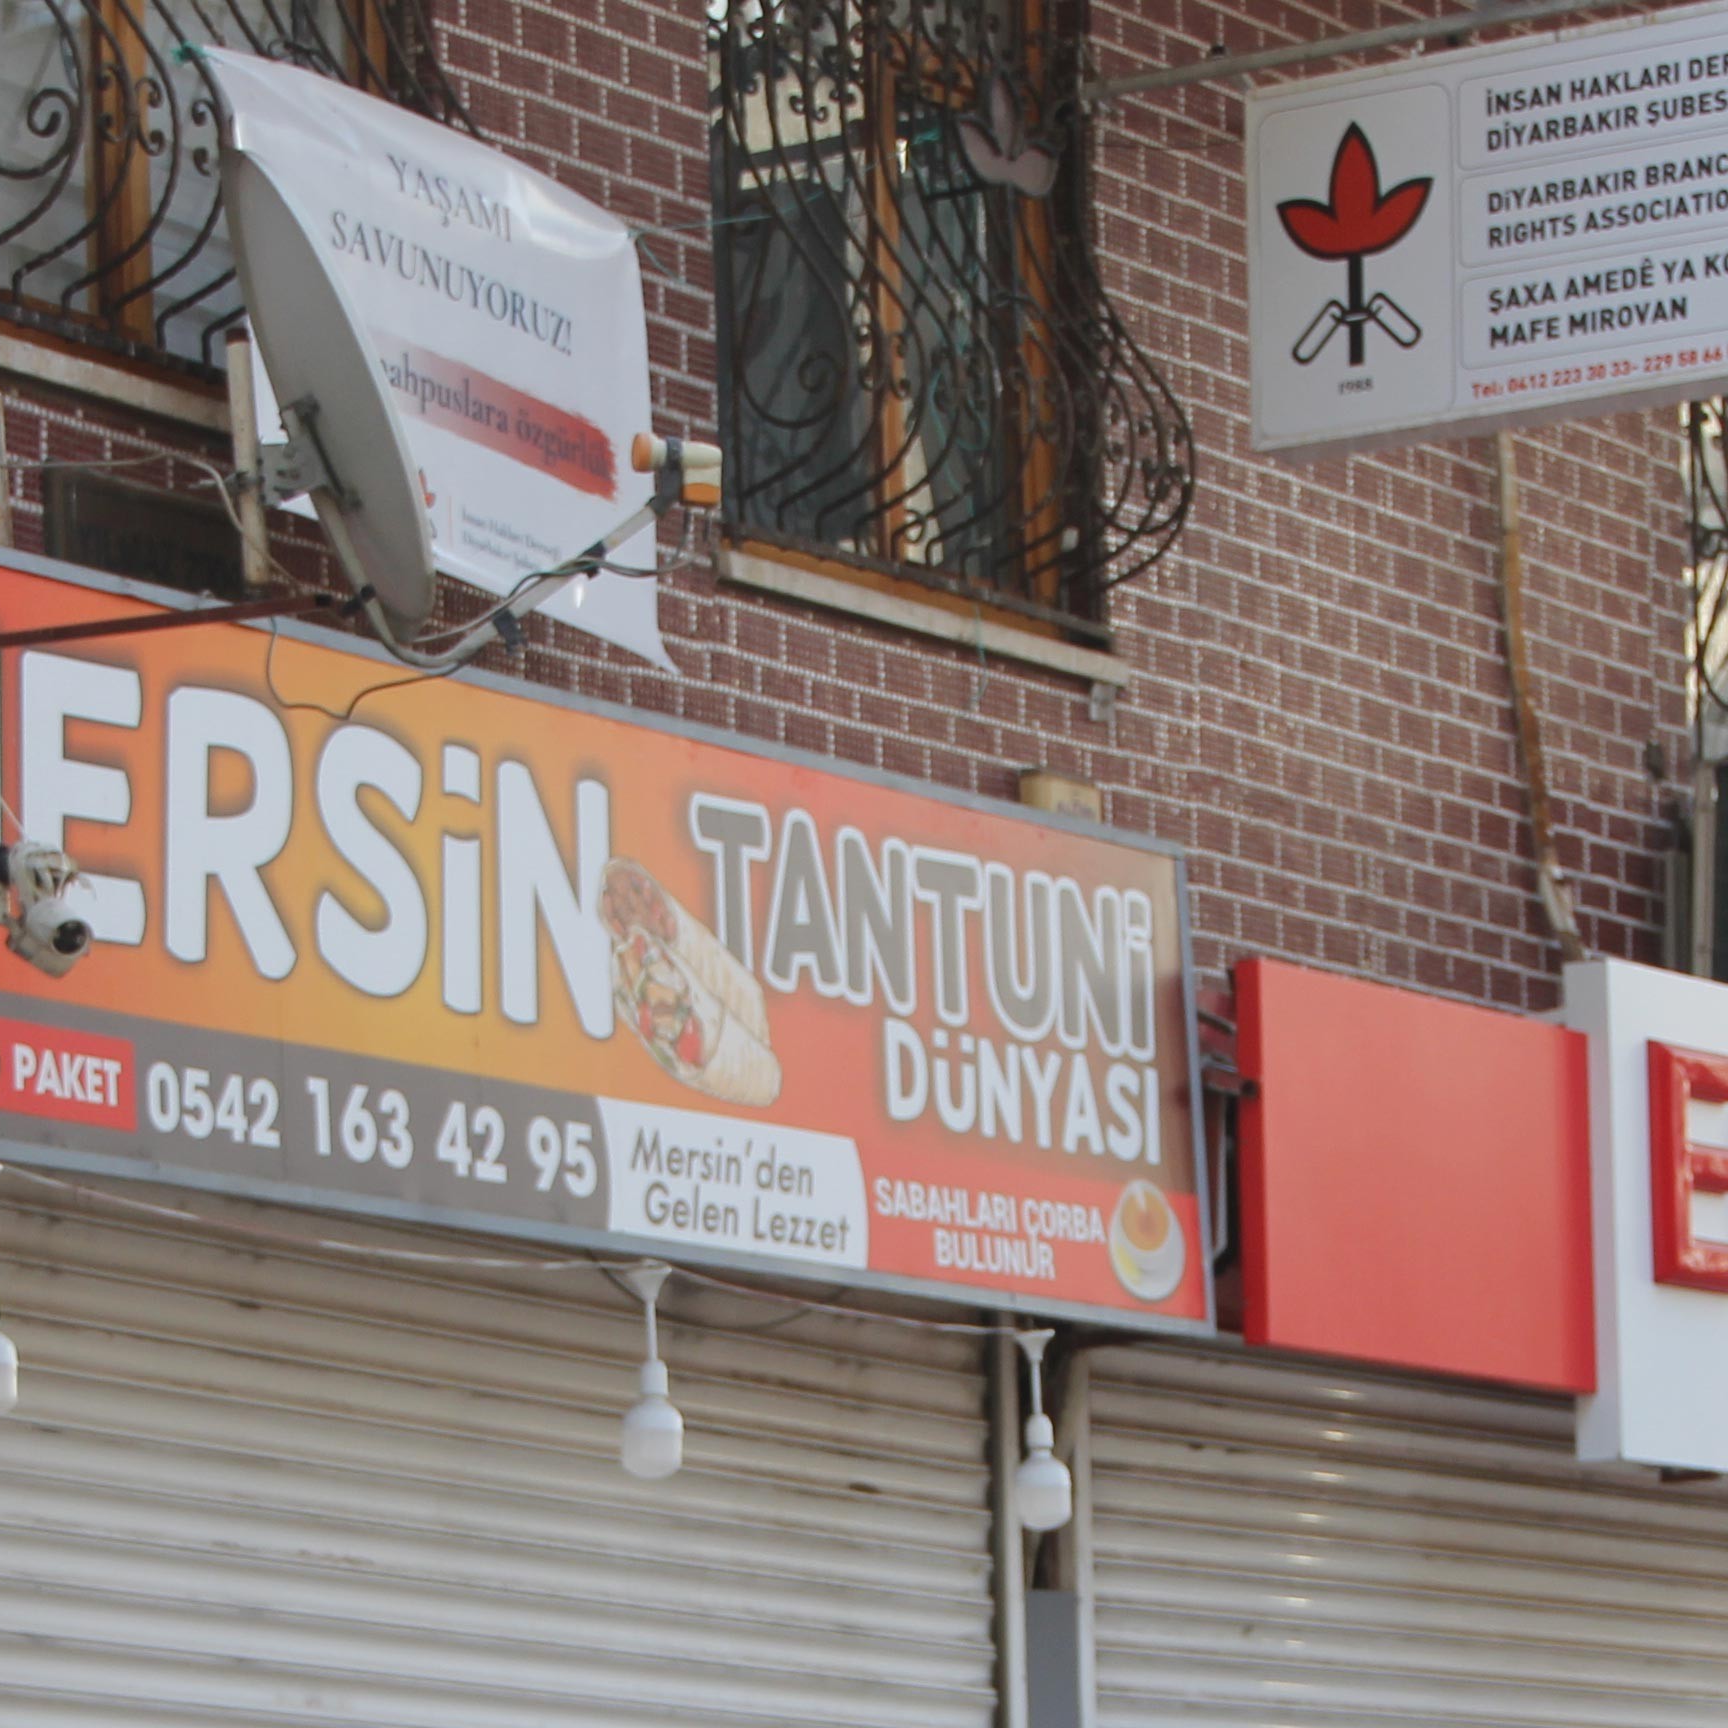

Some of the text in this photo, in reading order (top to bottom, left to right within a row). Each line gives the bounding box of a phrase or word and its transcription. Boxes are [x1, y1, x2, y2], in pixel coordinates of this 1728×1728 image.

[1486, 83, 1562, 117] İNSAN
[1571, 61, 1680, 103] HAKLARI
[1486, 105, 1639, 153] DİYARBAKIR
[386, 152, 513, 243] YAŞAMI
[1488, 214, 1577, 249] RIGHTS
[331, 209, 572, 358] SAVUNUYORUZ!
[1488, 279, 1556, 316] ŞAXA
[1564, 258, 1654, 300] AMEDÊ
[1660, 256, 1697, 284] YA
[1488, 297, 1689, 350] MAFE MIROVAN
[1507, 373, 1549, 394] 0412
[1552, 367, 1583, 387] 223
[1586, 363, 1607, 382] 30
[1643, 353, 1673, 374] 229
[1677, 350, 1698, 367] 58
[1702, 347, 1723, 364] 66
[12, 1043, 122, 1108] PAKET
[145, 1061, 281, 1149] 0542
[305, 1076, 414, 1170] 163
[435, 1101, 509, 1184] 42
[528, 1115, 598, 1198] 95
[883, 1017, 1162, 1166] DÜNYASI
[629, 1126, 815, 1197] Mersin'den
[643, 1180, 851, 1254] Gelen Lezzet
[874, 1177, 1108, 1245] SABAHLARI ÇORBA
[933, 1228, 1057, 1280] BULUNUR
